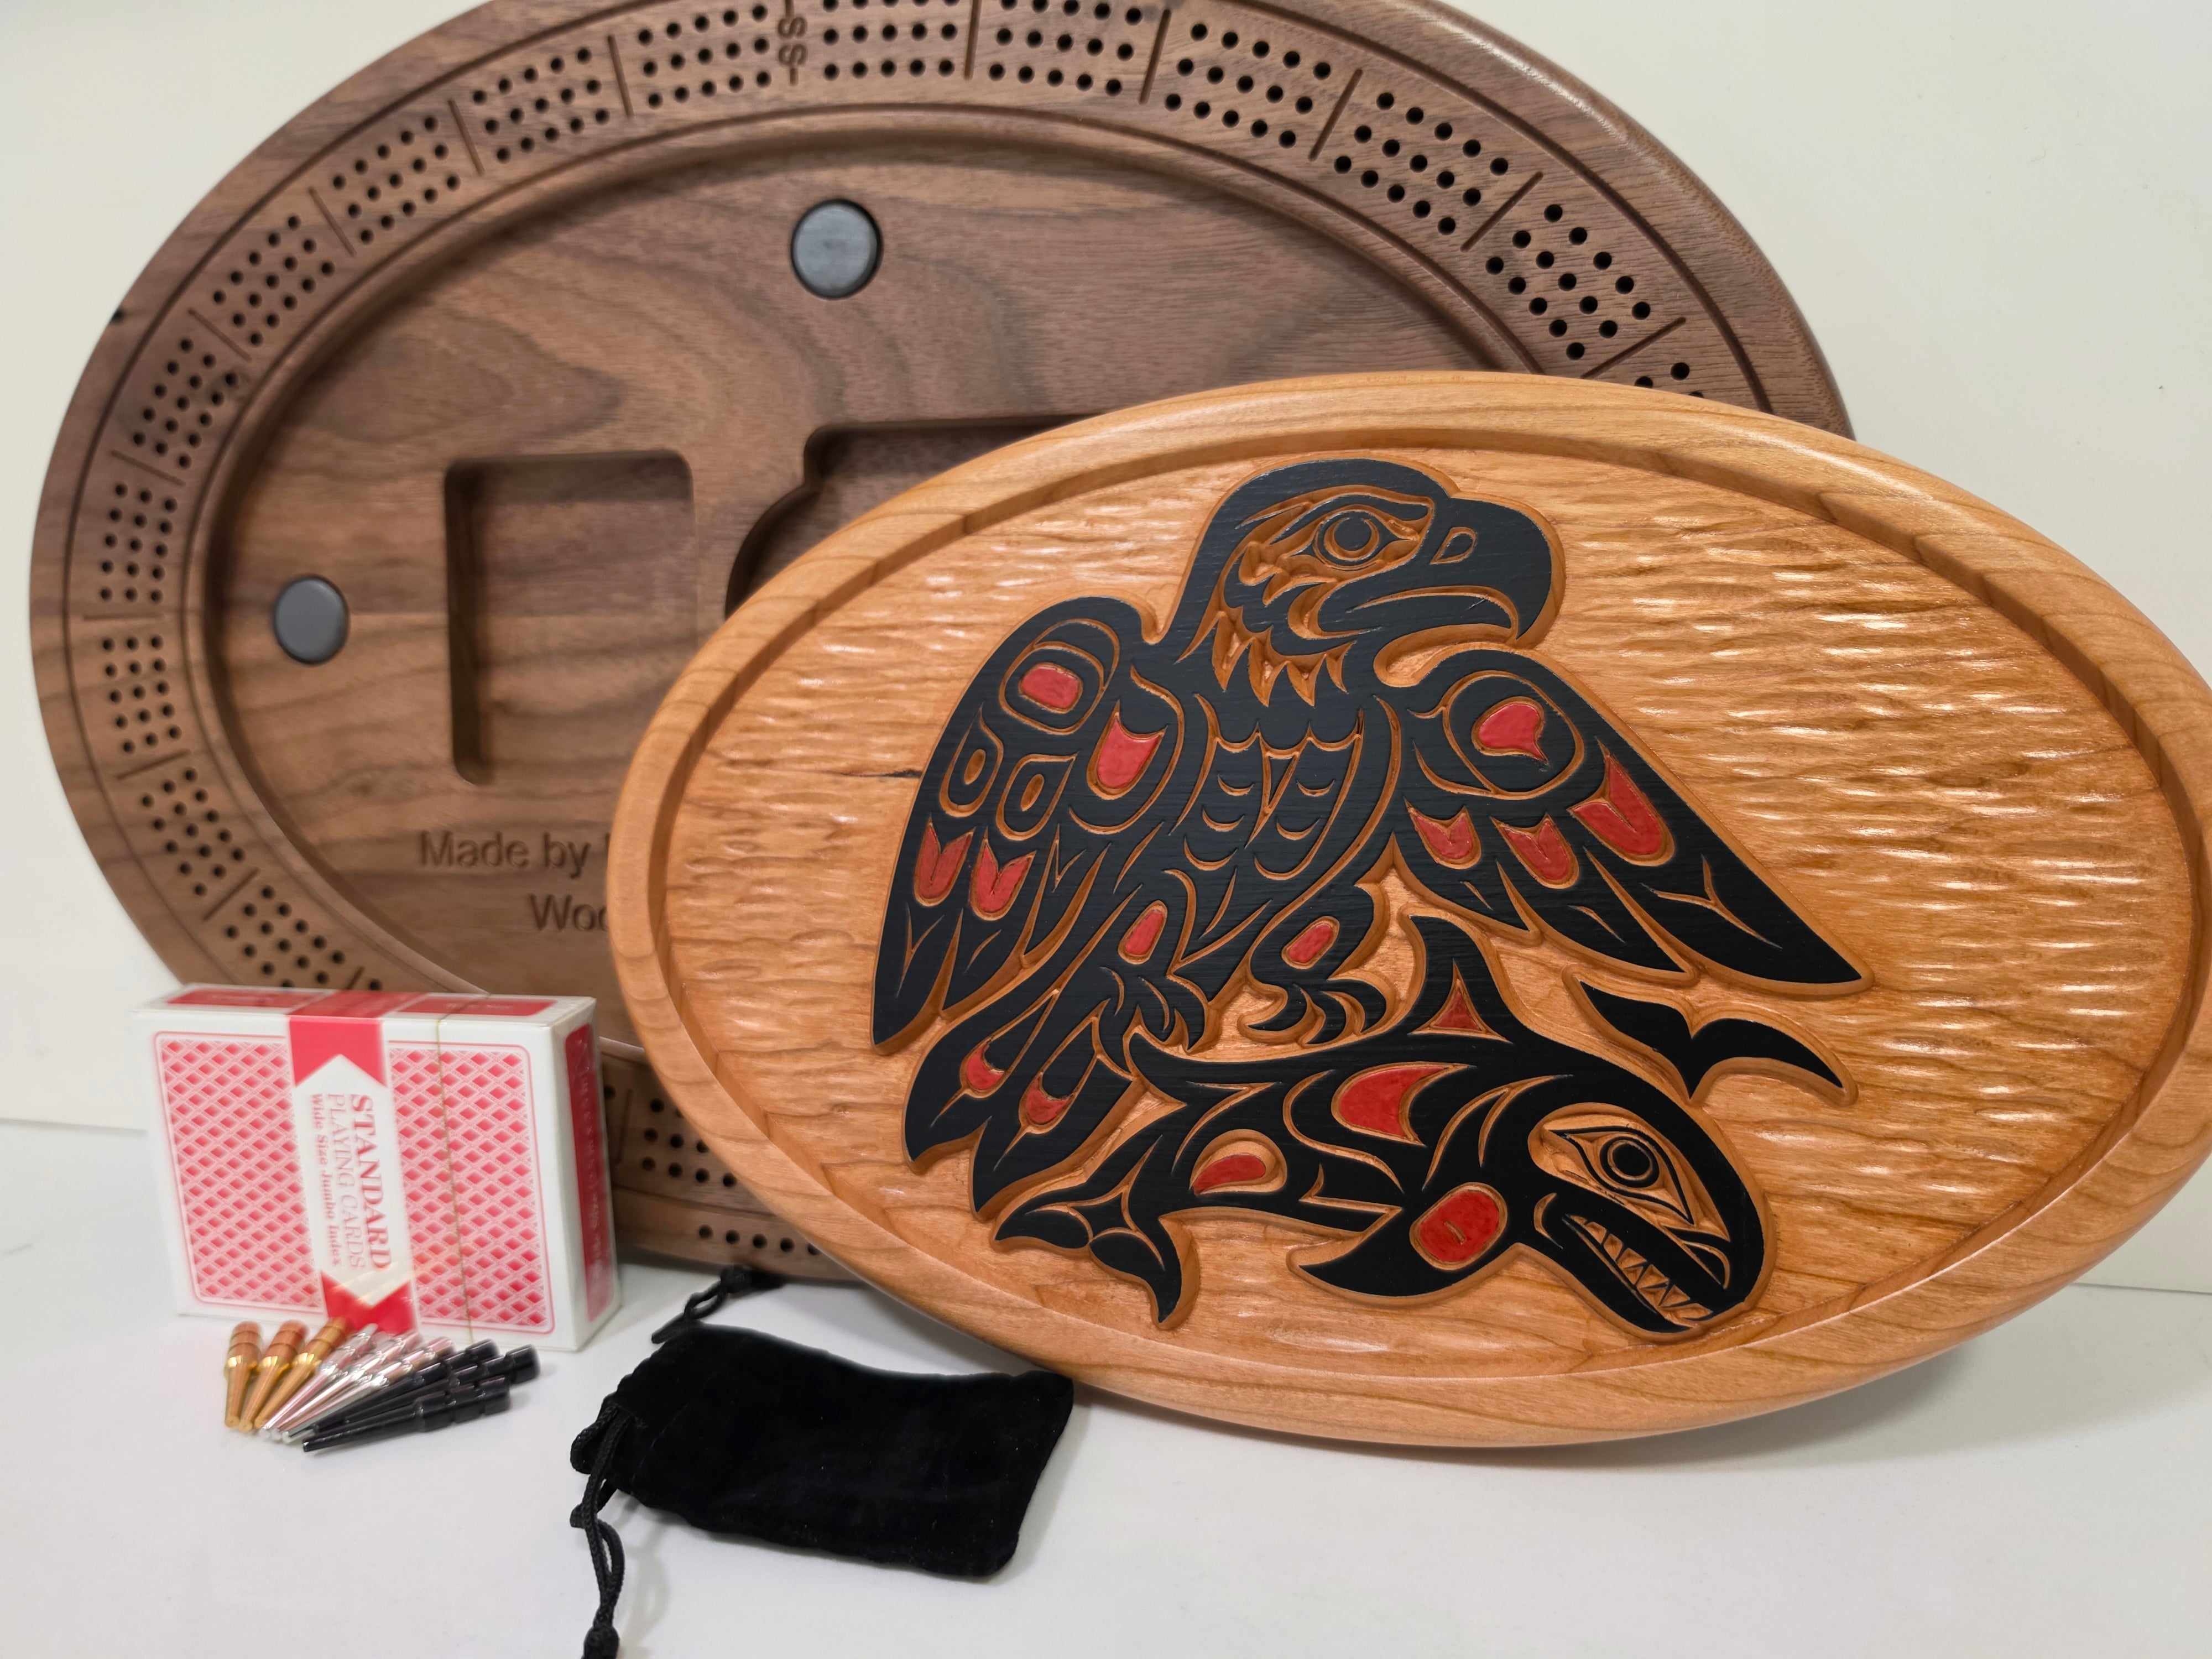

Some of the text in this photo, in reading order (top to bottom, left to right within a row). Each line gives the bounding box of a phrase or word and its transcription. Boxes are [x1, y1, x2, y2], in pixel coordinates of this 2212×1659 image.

[419, 831, 530, 868] Made
[543, 832, 592, 879] by
[310, 1094, 343, 1266] Wide Size Jumbo Index
[328, 1093, 366, 1269] PLAYING CARDS
[351, 1093, 392, 1269] STANDARD
